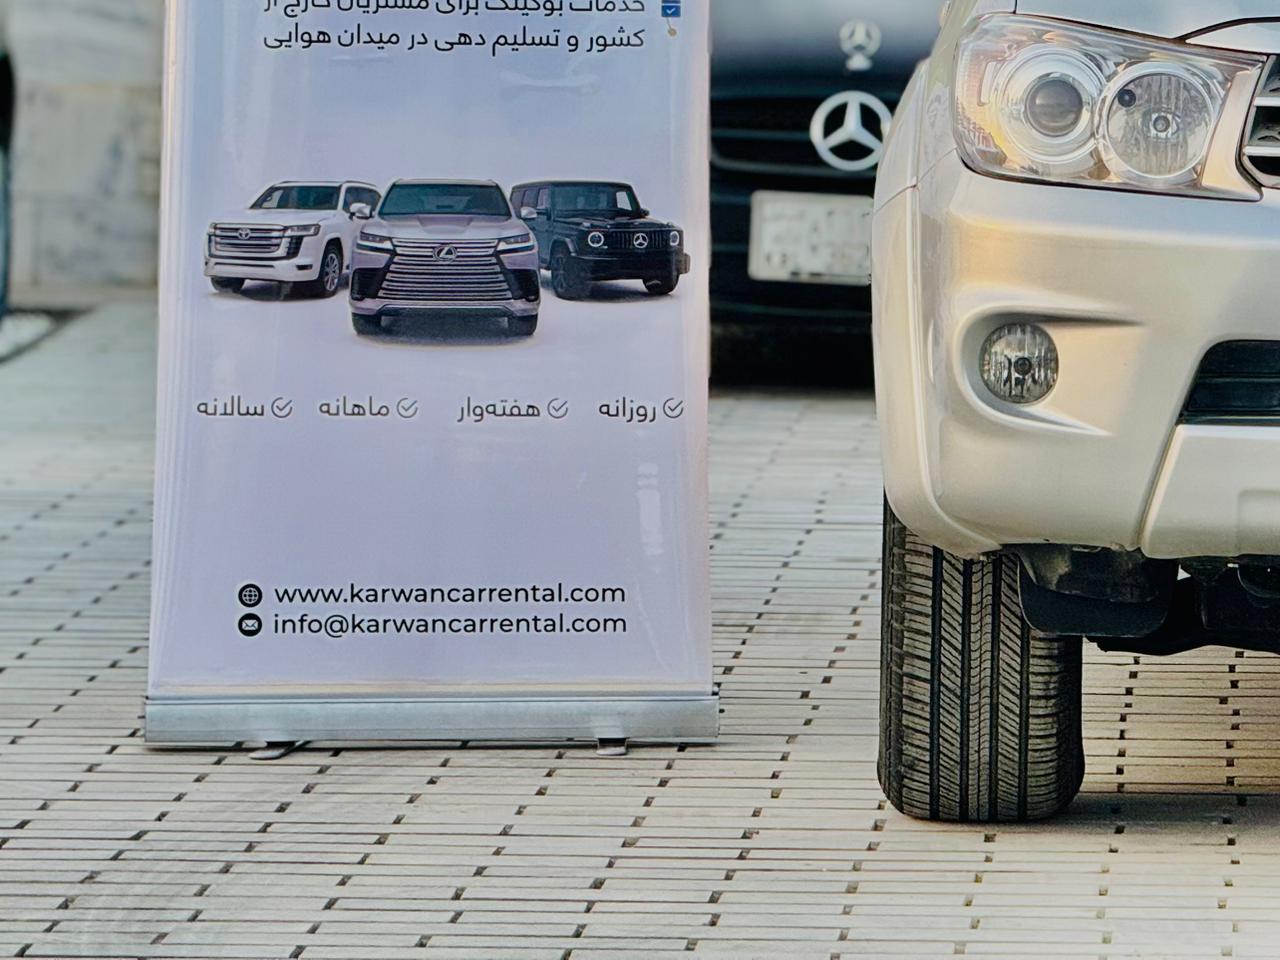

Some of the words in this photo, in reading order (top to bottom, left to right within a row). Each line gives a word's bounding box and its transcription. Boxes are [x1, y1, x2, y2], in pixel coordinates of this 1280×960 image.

[263, 22, 332, 50] هوایی
[337, 23, 401, 50] میدان
[407, 31, 429, 51] در
[434, 28, 487, 52] دهی
[491, 26, 561, 58] تسلیم
[566, 34, 579, 53] و
[586, 26, 646, 53] کشور
[196, 396, 265, 417] سالانه
[318, 396, 390, 417] ماهانه
[598, 396, 657, 423] روزانه
[274, 582, 626, 604] www.karwancarrental.com
[273, 613, 628, 639] info@karwancarrental.com
